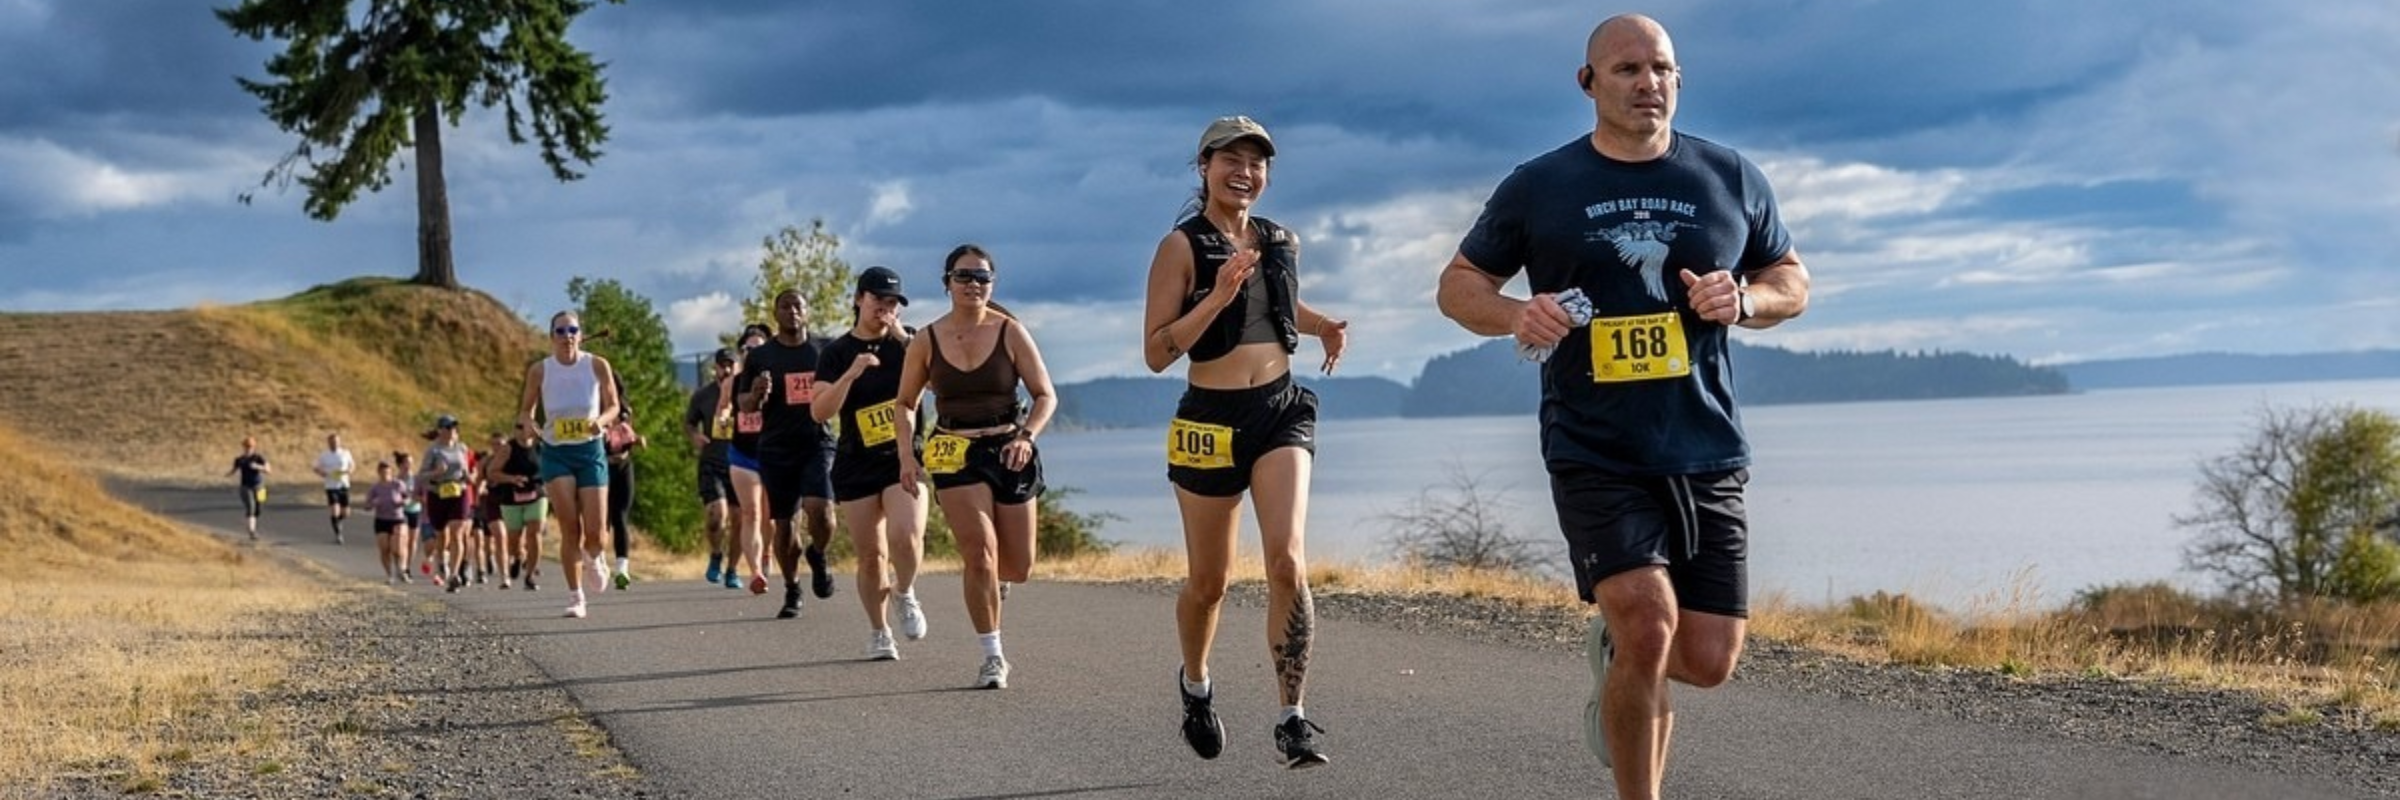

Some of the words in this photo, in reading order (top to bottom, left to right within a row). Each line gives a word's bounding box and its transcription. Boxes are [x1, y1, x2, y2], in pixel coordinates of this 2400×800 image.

[1585, 200, 1617, 219] BIRCH
[1618, 198, 1638, 211] BAY
[1641, 198, 1669, 211] ROAD
[1670, 200, 1696, 217] RACE
[1611, 325, 1668, 360] 168
[1631, 363, 1651, 373] 10K
[868, 407, 896, 428] 110
[1175, 428, 1214, 457] 109
